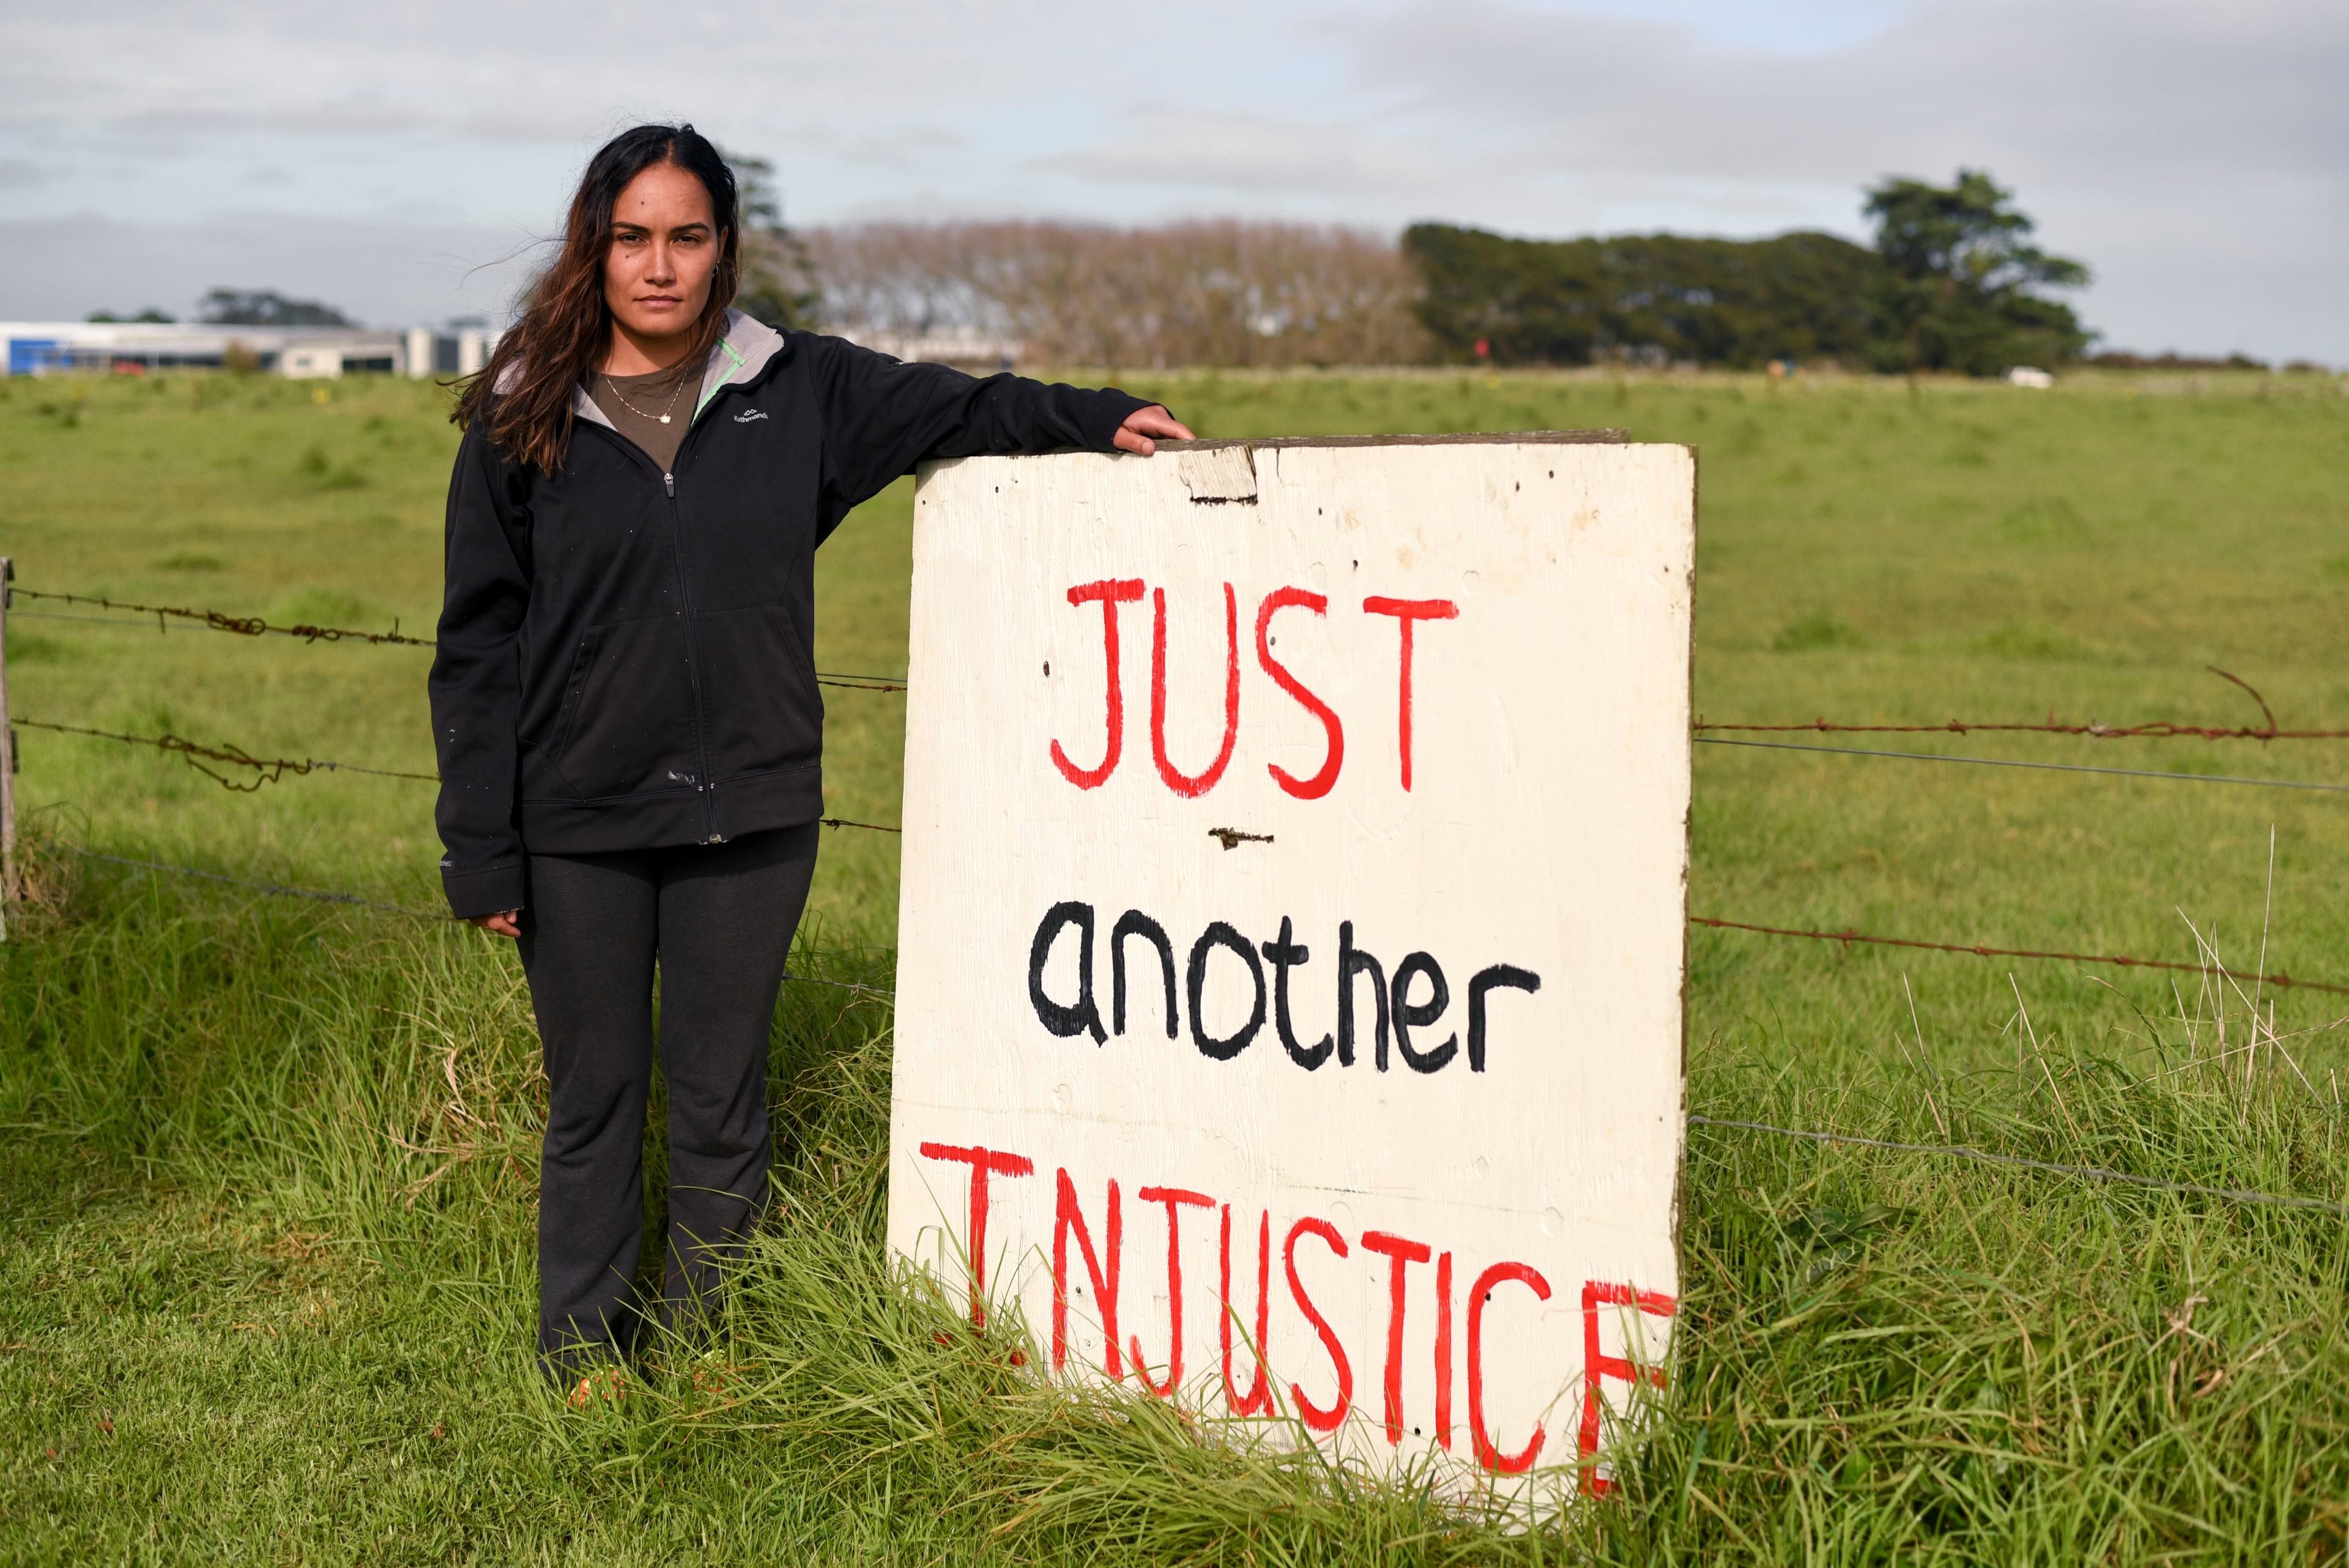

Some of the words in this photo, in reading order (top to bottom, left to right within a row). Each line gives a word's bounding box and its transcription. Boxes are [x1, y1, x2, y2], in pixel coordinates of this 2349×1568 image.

[1050, 578, 1459, 800] JUST
[1029, 901, 1540, 1073] another
[920, 1142, 1677, 1499] INJUSTICE
